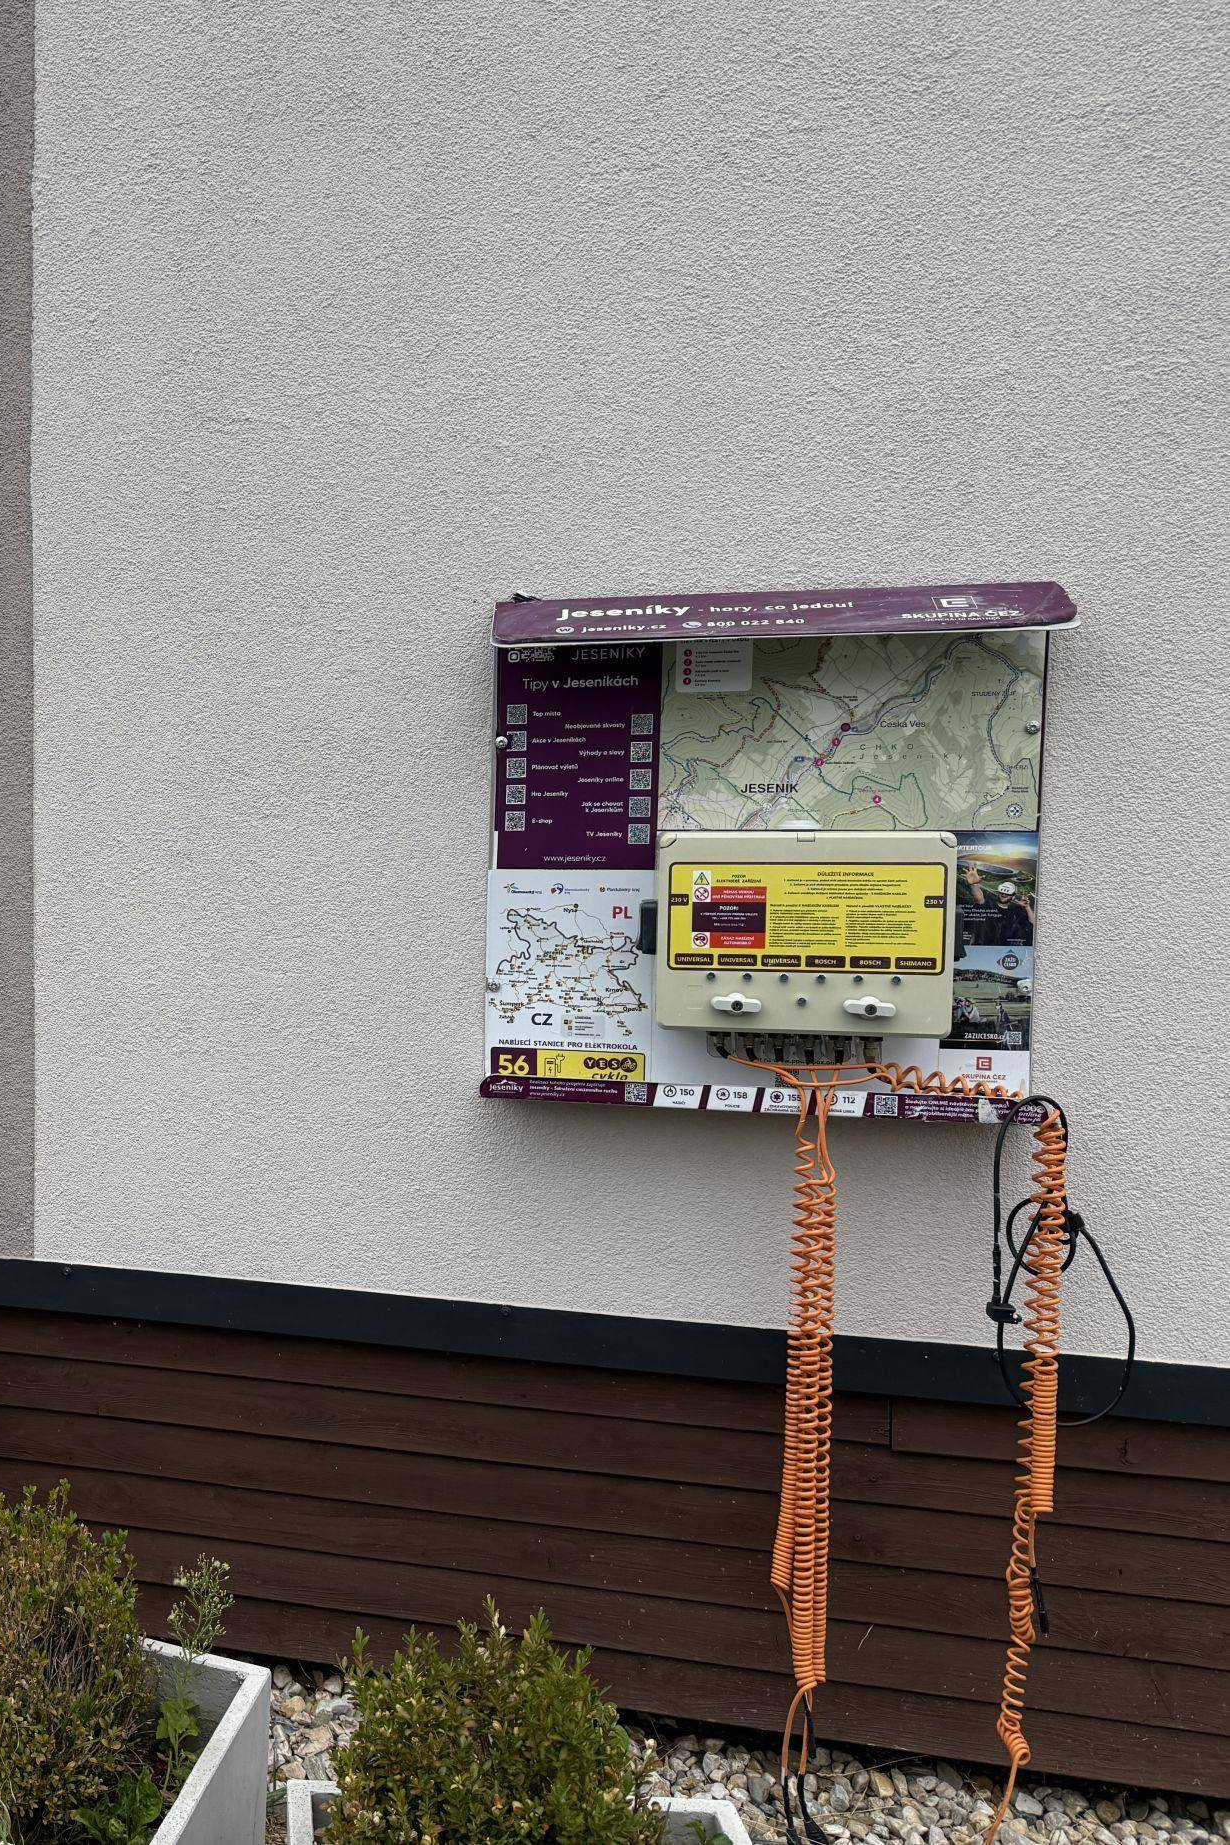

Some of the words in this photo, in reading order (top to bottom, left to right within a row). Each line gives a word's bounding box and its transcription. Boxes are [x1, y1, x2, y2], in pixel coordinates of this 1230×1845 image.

[556, 604, 691, 621] Jeseníky
[901, 611, 980, 619] SKUPINA
[984, 609, 1022, 617] ČEZ
[581, 624, 667, 633] jeseniky.cz
[571, 645, 646, 661] JESENÍKY
[522, 678, 549, 692] Tipy
[551, 680, 560, 688] v
[909, 720, 926, 728] Ves
[578, 749, 602, 757] Výhody
[559, 763, 579, 771] výletů
[577, 776, 604, 784] Jeseníky
[740, 782, 798, 794] JESENÍK
[543, 790, 569, 798] Jeseníky
[595, 830, 622, 838] Jeseníky
[543, 854, 606, 863] www.jeseniky.cz
[612, 906, 633, 919] PL
[531, 1013, 553, 1026] CZ
[498, 1038, 531, 1046] NABÍJECÍ
[533, 1040, 565, 1048] STANICE
[584, 1043, 638, 1051] ELEKTROKOLA
[498, 1054, 530, 1075] 56
[585, 1059, 619, 1069] YES
[489, 1083, 524, 1093] Jeseníky
[679, 1088, 695, 1096] 150
[732, 1091, 748, 1099] 158
[787, 1094, 802, 1102] 155
[842, 1096, 856, 1104] 112
